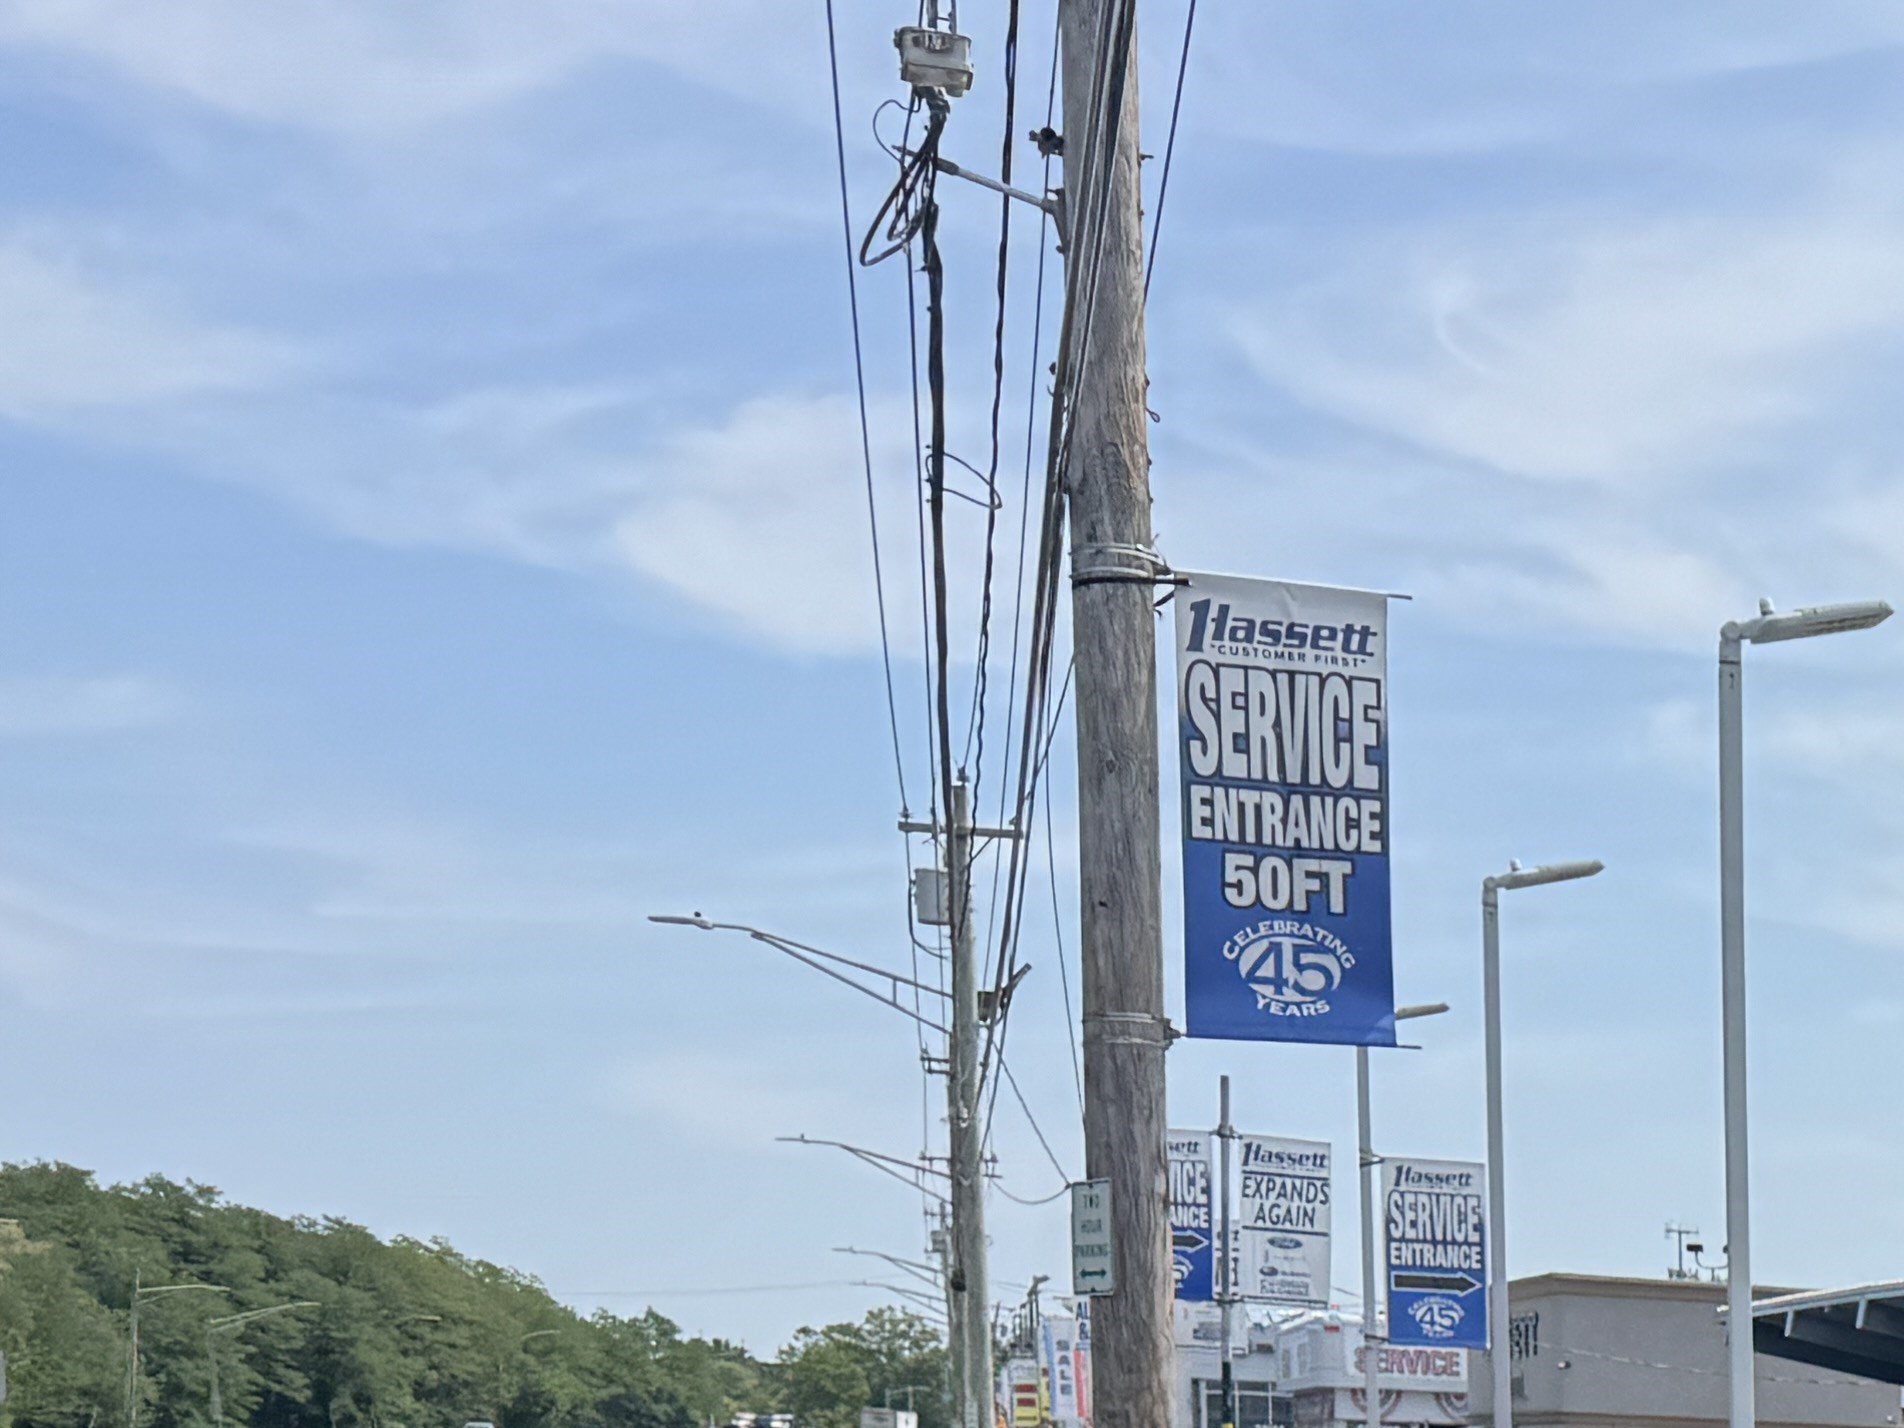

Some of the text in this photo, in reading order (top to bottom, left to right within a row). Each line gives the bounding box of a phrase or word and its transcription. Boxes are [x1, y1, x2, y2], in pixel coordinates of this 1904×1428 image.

[1186, 599, 1377, 657] Hassett
[1186, 661, 1382, 790] SERVICE
[1190, 785, 1383, 854] ENTRANCE
[1223, 852, 1352, 916] 50FT
[1222, 920, 1356, 970] CELEBRATING
[1240, 940, 1340, 998] 45
[1255, 996, 1330, 1017] YEARS
[1241, 1141, 1328, 1168] Hassett
[1241, 1176, 1330, 1206] EXPANDS
[1393, 1164, 1474, 1188] Hassett
[1253, 1203, 1316, 1229] AGAIN
[1389, 1189, 1481, 1244] SERVICE
[1390, 1241, 1482, 1270] ENTRANCE
[1416, 1304, 1457, 1332] 45
